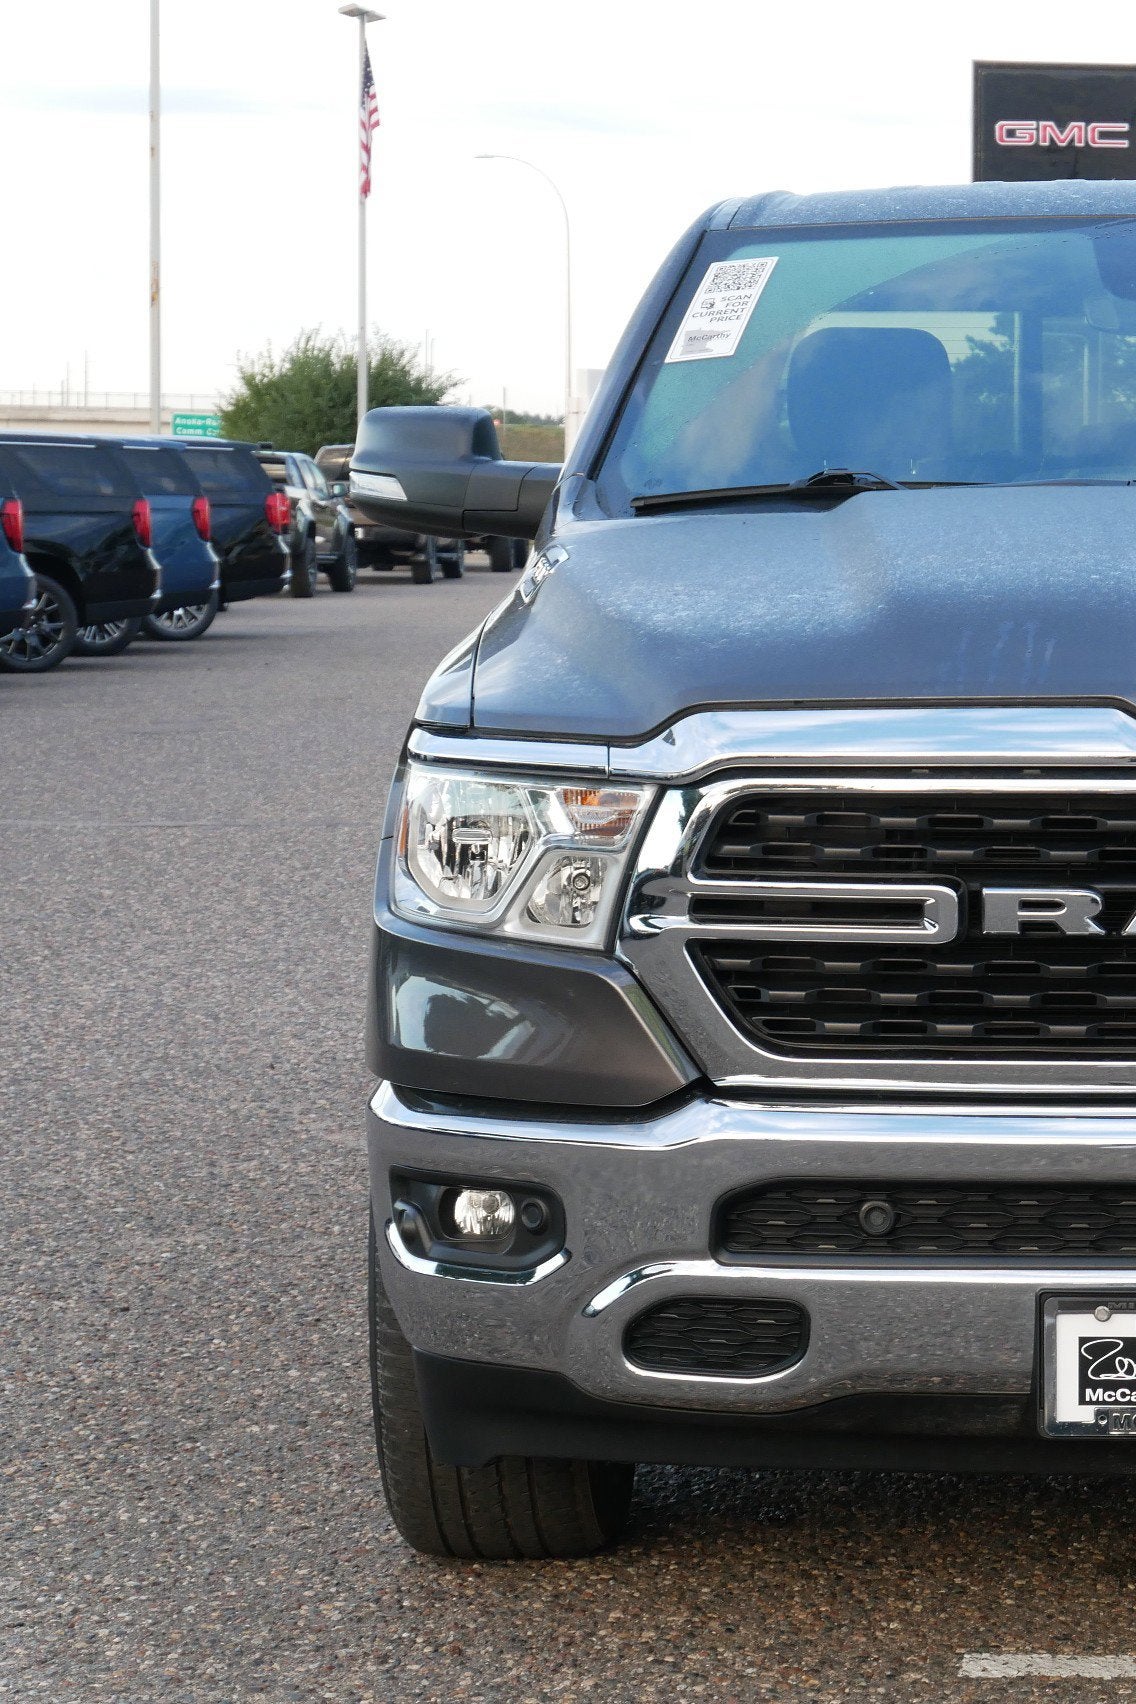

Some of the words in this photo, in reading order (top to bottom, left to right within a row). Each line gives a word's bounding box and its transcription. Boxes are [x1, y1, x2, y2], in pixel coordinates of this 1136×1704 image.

[995, 121, 1129, 148] GMC
[721, 294, 752, 302] SCAN
[692, 307, 746, 318] CURRENT
[709, 314, 742, 322] PRICE
[688, 331, 732, 342] McCarthy
